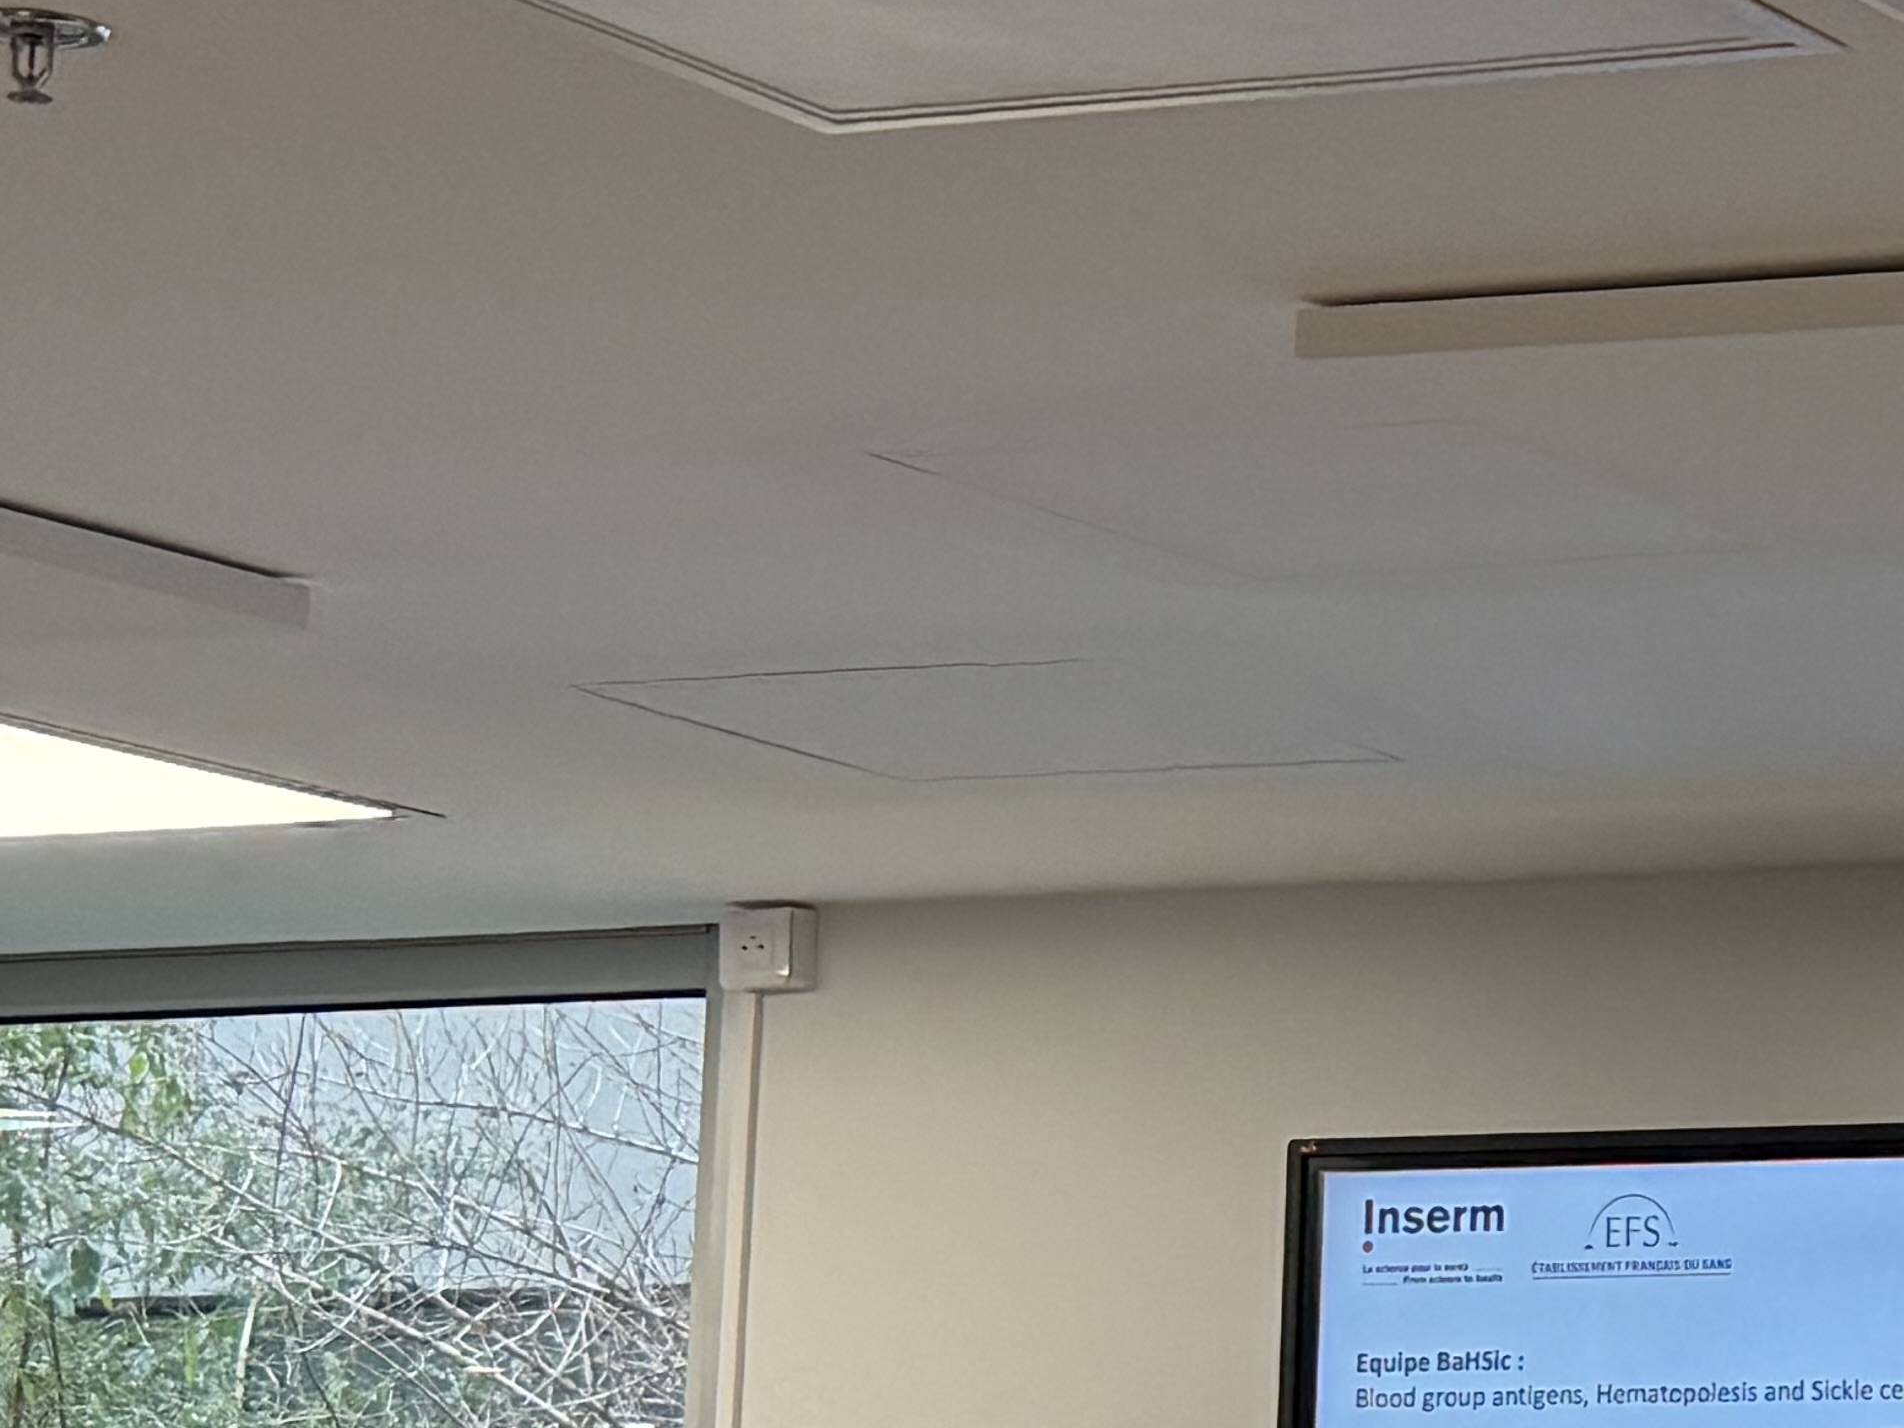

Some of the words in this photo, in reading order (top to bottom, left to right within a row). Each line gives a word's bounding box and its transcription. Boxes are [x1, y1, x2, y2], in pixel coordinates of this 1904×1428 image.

[1363, 1198, 1505, 1235] Inserm
[1605, 1215, 1661, 1249] EFS
[1356, 1351, 1431, 1378] Equipe
[1436, 1349, 1512, 1372] BaHSic
[1355, 1385, 1417, 1409] Blood
[1421, 1390, 1486, 1413] group
[1492, 1384, 1589, 1411] antigens,
[1763, 1379, 1805, 1402] and
[1811, 1378, 1874, 1402] Sickle
